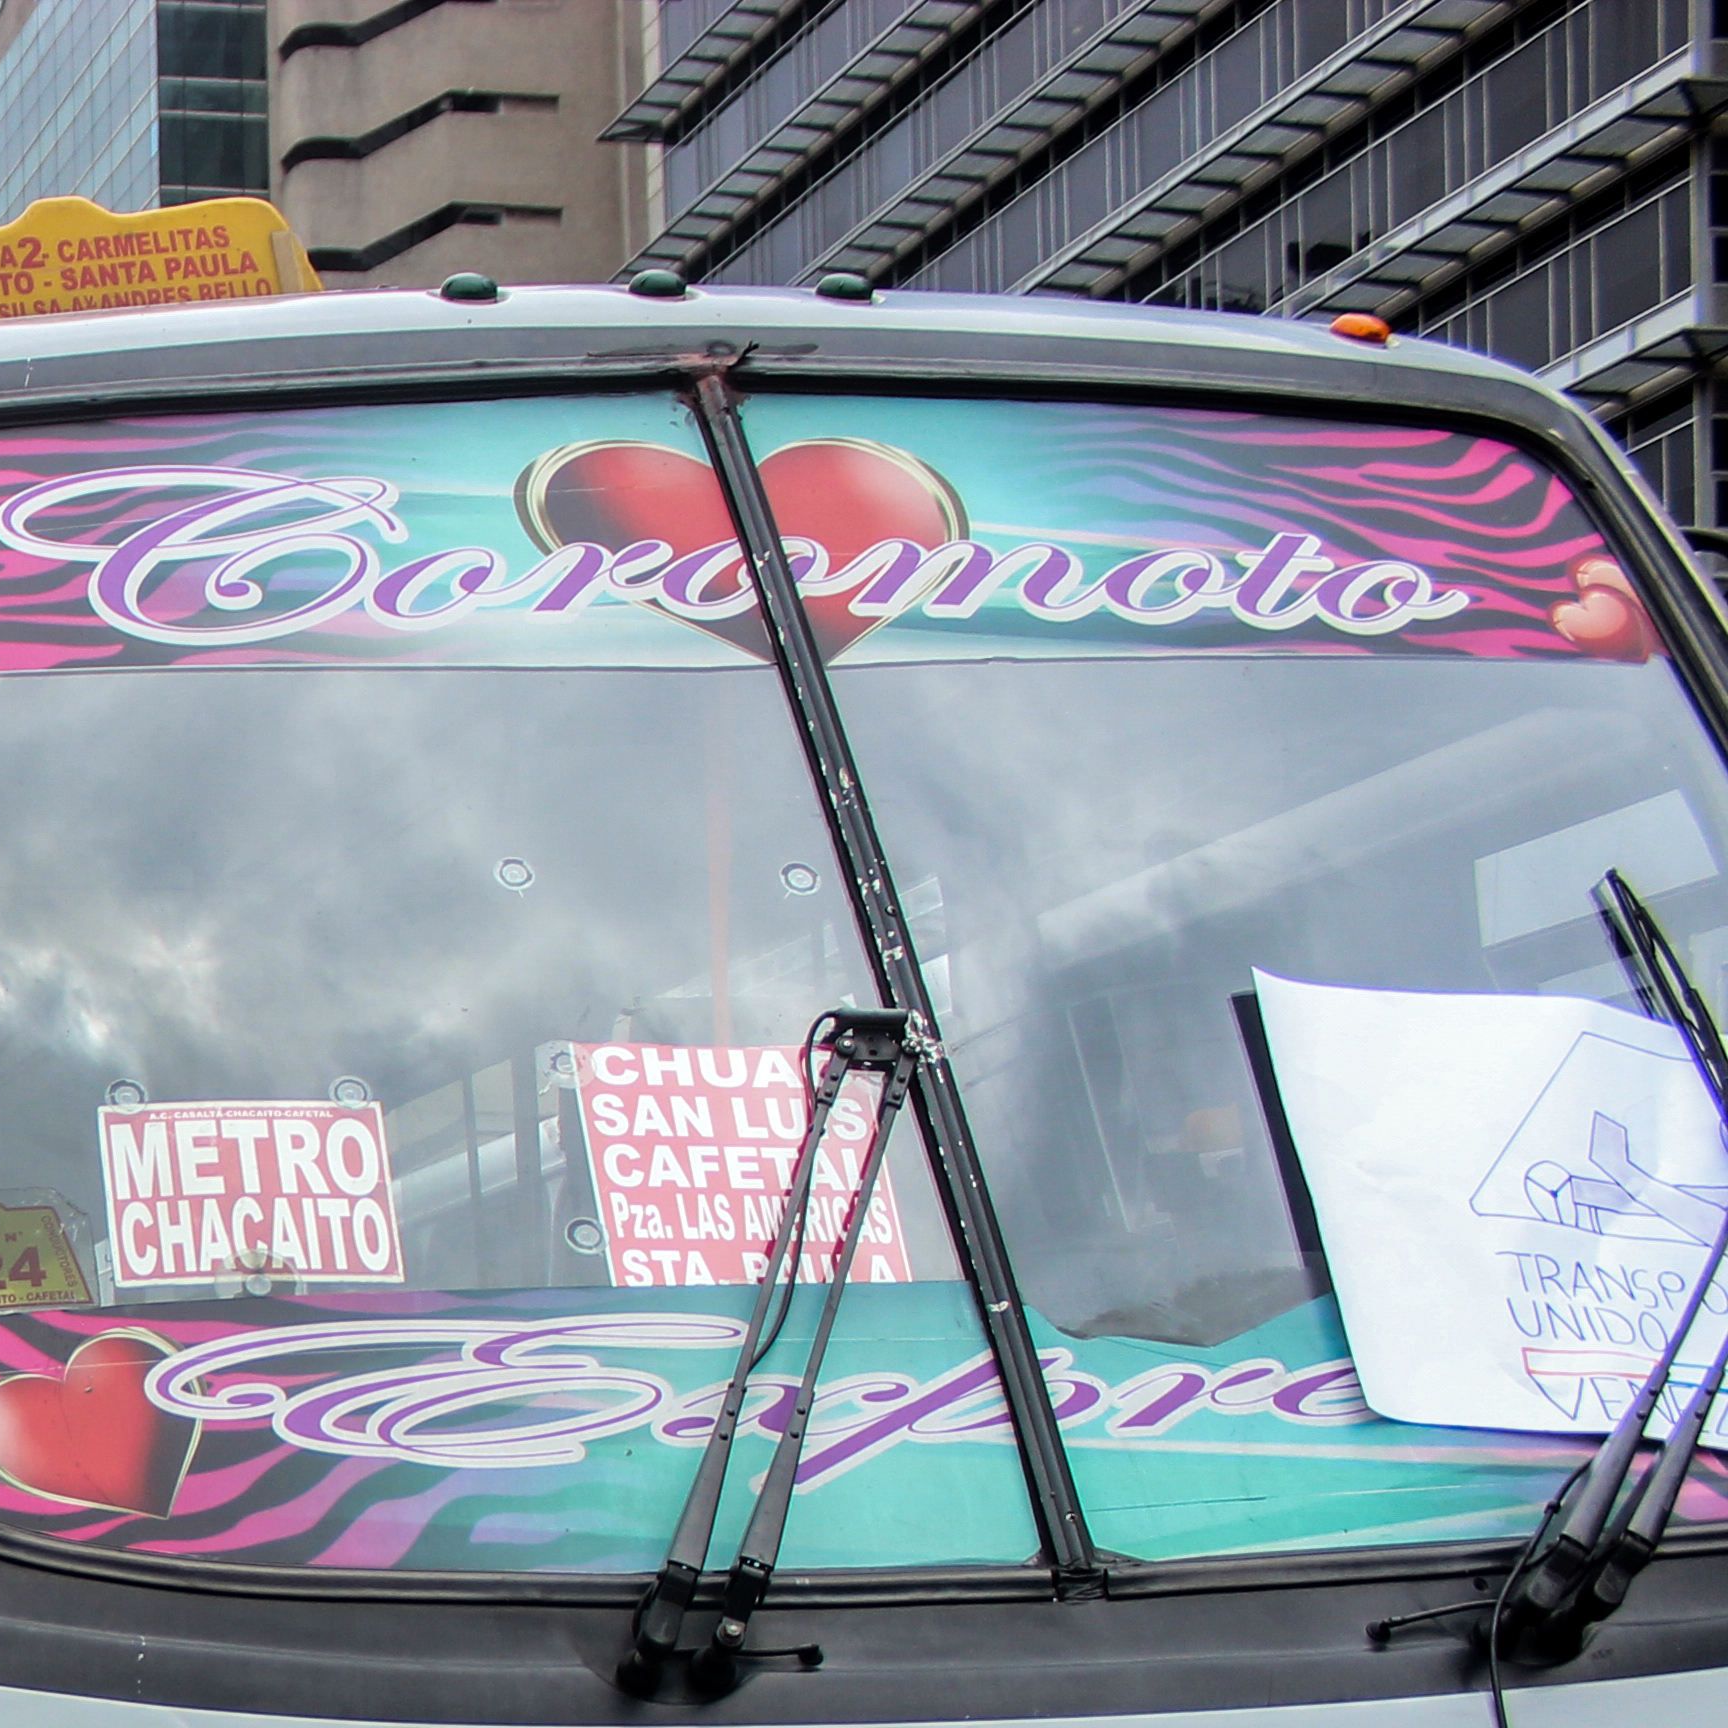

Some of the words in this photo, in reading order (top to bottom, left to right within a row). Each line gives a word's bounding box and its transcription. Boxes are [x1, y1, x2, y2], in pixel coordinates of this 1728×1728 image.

[58, 225, 231, 263] CARMELITAS
[61, 259, 157, 291] SANTA
[164, 251, 259, 281] PAULA
[592, 1094, 715, 1138] SAN
[731, 1097, 868, 1141] LUS
[109, 1117, 380, 1200] METRO
[122, 1196, 390, 1276] CHACAITO
[611, 1192, 674, 1240] Pza.
[675, 1193, 736, 1242] LAS
[26, 1290, 76, 1302] CAFETAL
[1506, 1297, 1670, 1353] UNIDO
